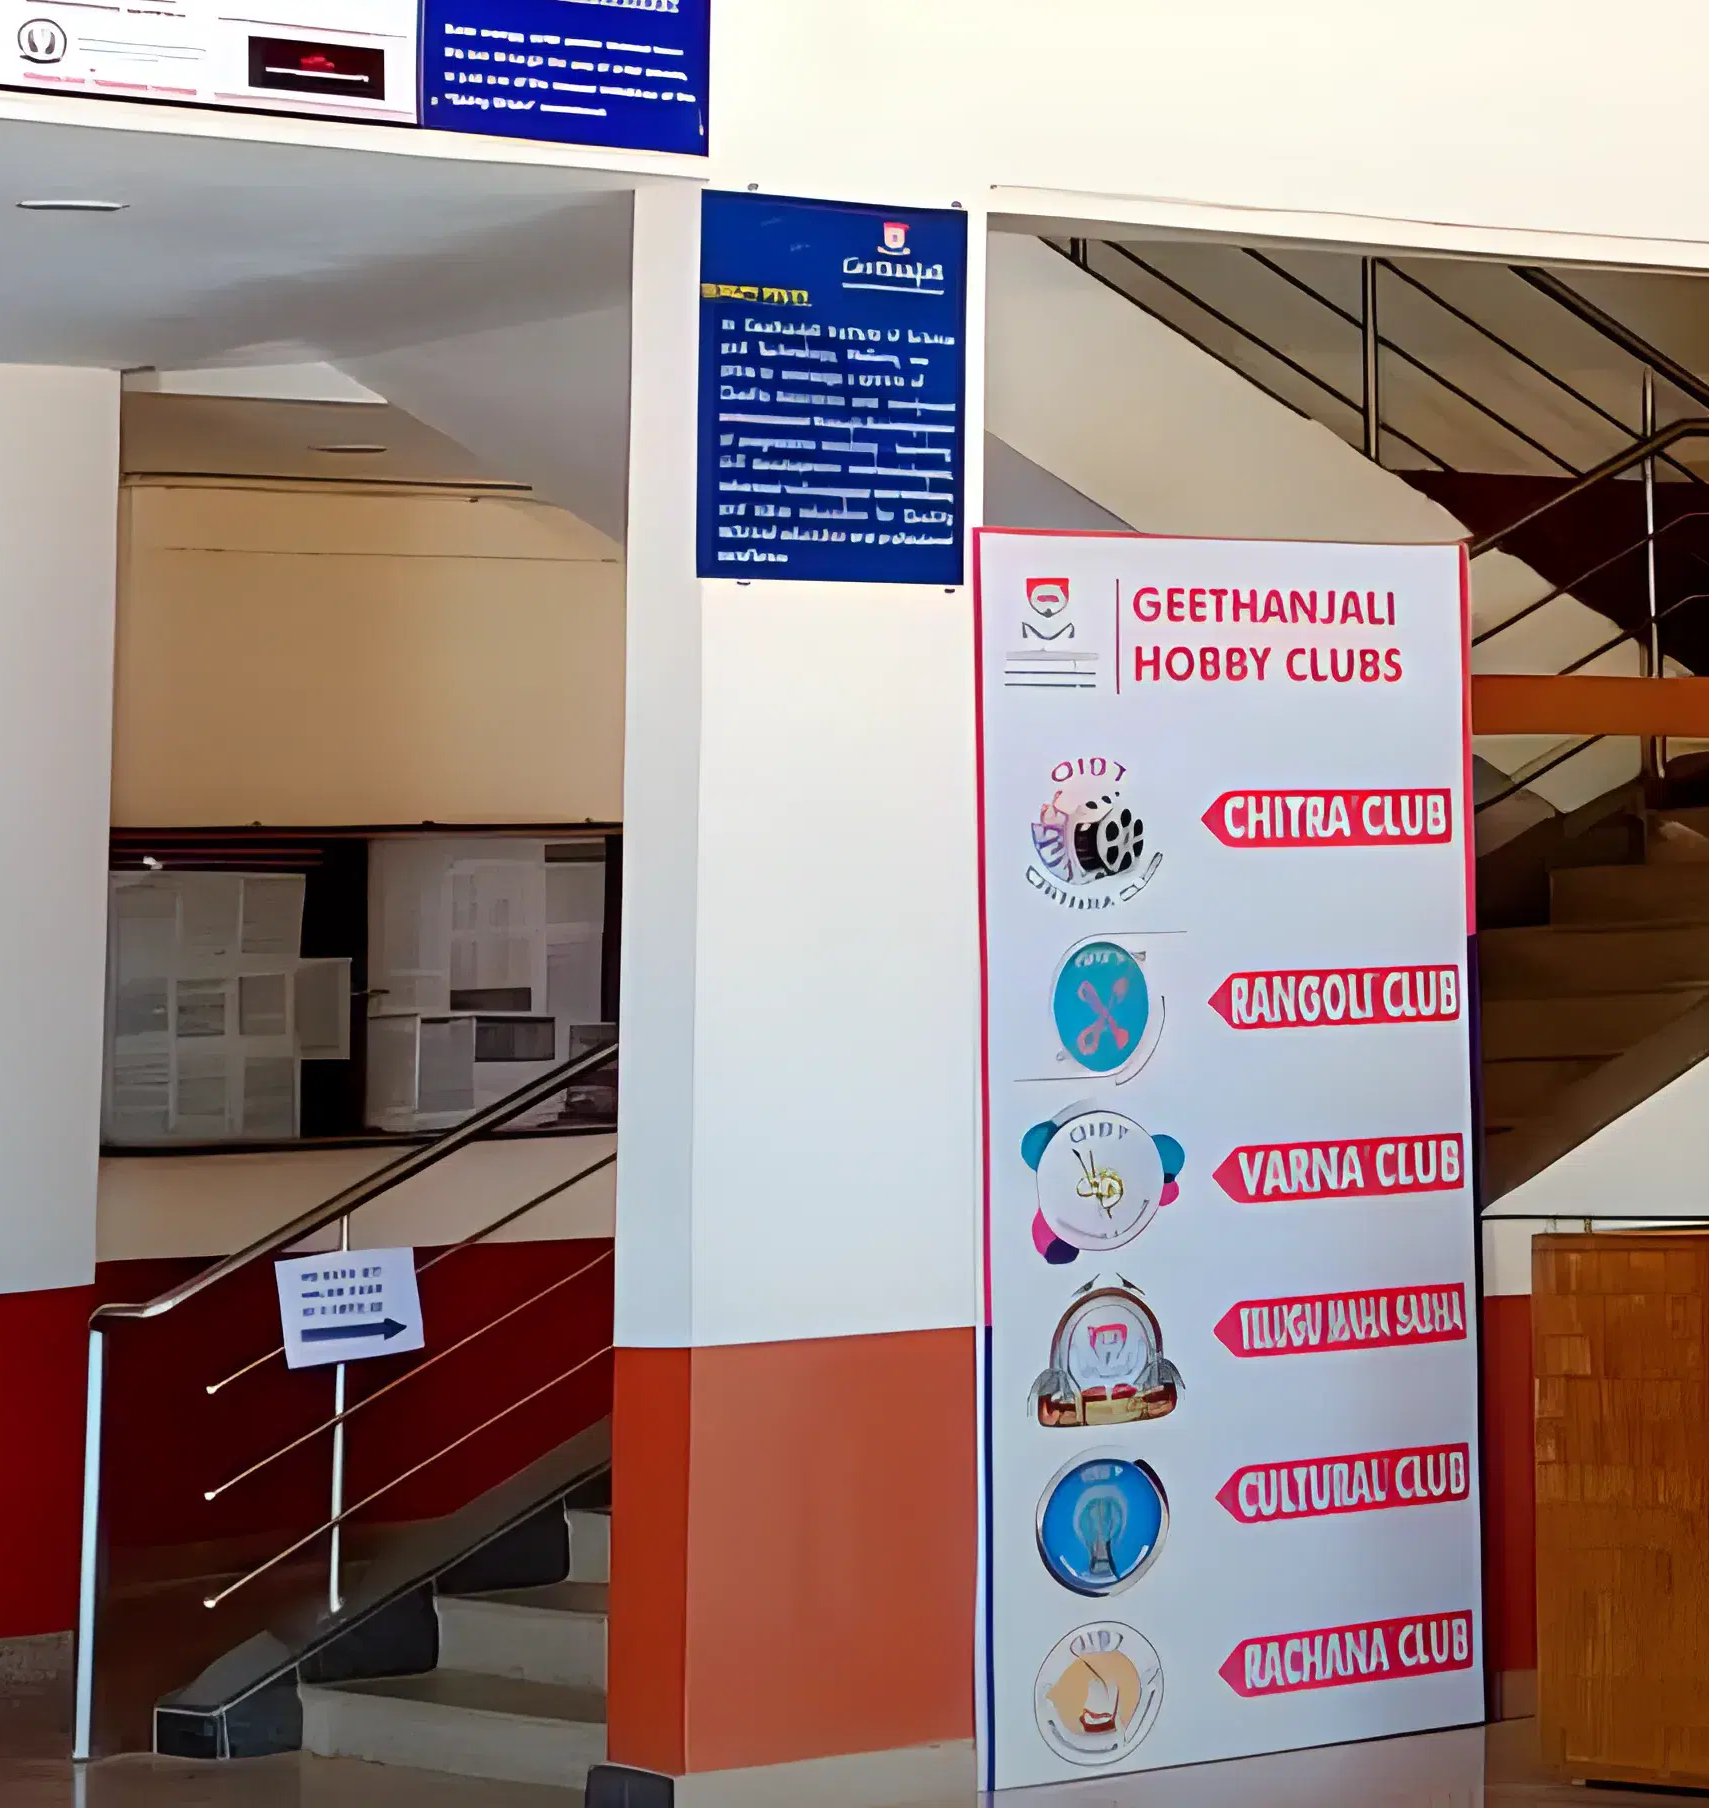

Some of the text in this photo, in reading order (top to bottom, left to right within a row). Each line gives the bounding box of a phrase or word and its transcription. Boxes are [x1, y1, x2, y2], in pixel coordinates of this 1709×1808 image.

[1133, 587, 1396, 626] GEETHANJALI
[1135, 646, 1402, 683] HOBBY CLUBS
[1224, 793, 1446, 838] CHITRA CLUB
[1231, 969, 1458, 1025] RANGOLI CLUB
[1238, 1138, 1461, 1196] VARNA CLUB
[1238, 1449, 1467, 1518] CULTURAL CLUB
[1245, 1616, 1468, 1690] RACHANA CLUB
